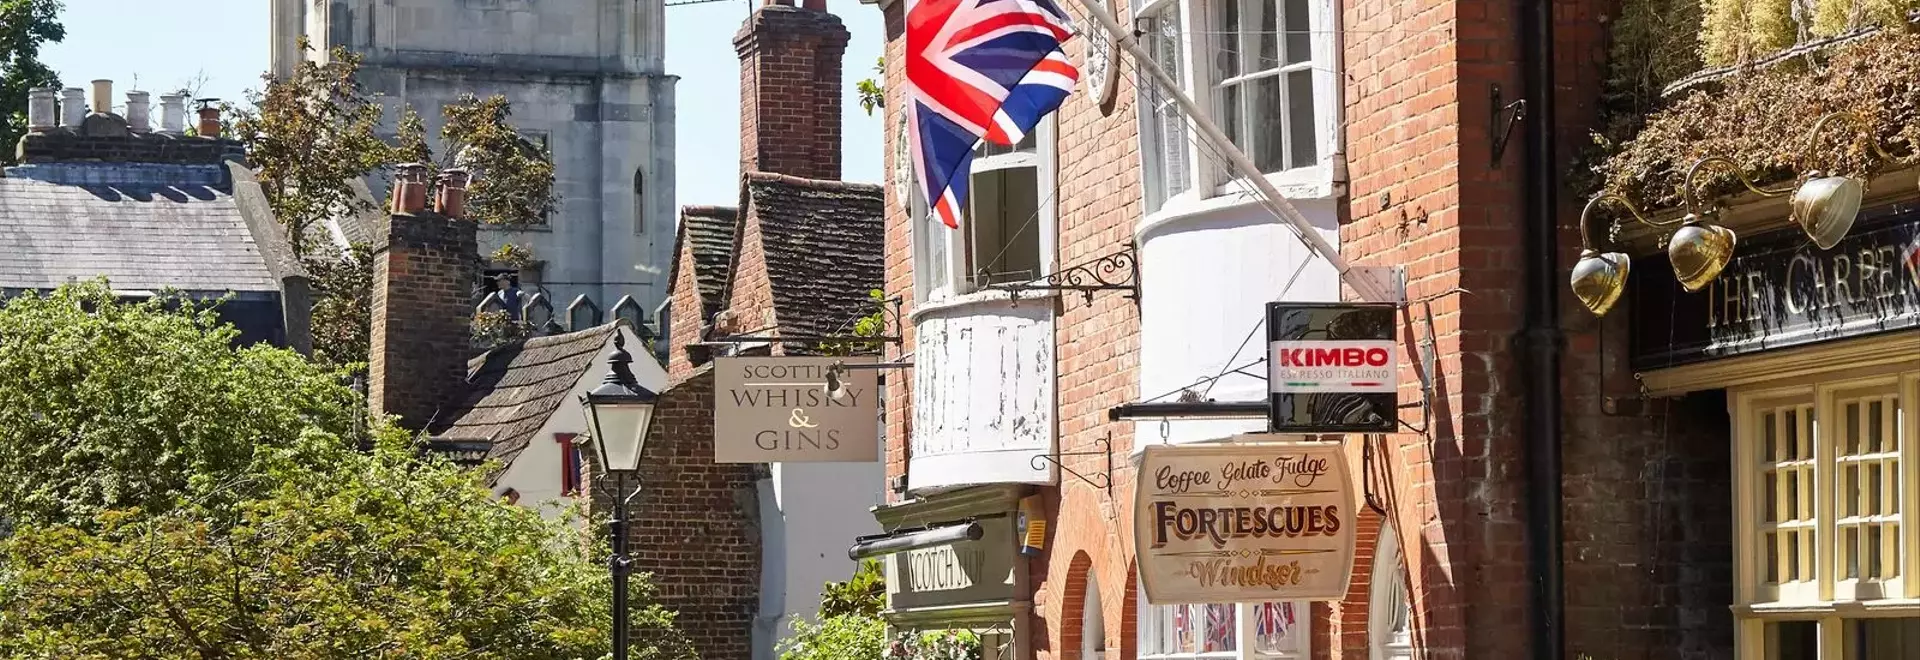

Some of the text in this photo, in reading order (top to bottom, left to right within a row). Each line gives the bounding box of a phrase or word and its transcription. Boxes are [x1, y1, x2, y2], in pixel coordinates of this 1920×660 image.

[1280, 347, 1389, 367] KIMBO
[743, 364, 852, 379] SCOTTI
[1338, 369, 1389, 379] ITALIANO
[788, 408, 818, 428] &
[755, 430, 840, 451] GINS
[1155, 453, 1329, 495] Coffee Gelato Fudge
[1149, 500, 1341, 549] FORTESCUES
[1188, 555, 1303, 591] Windsor
